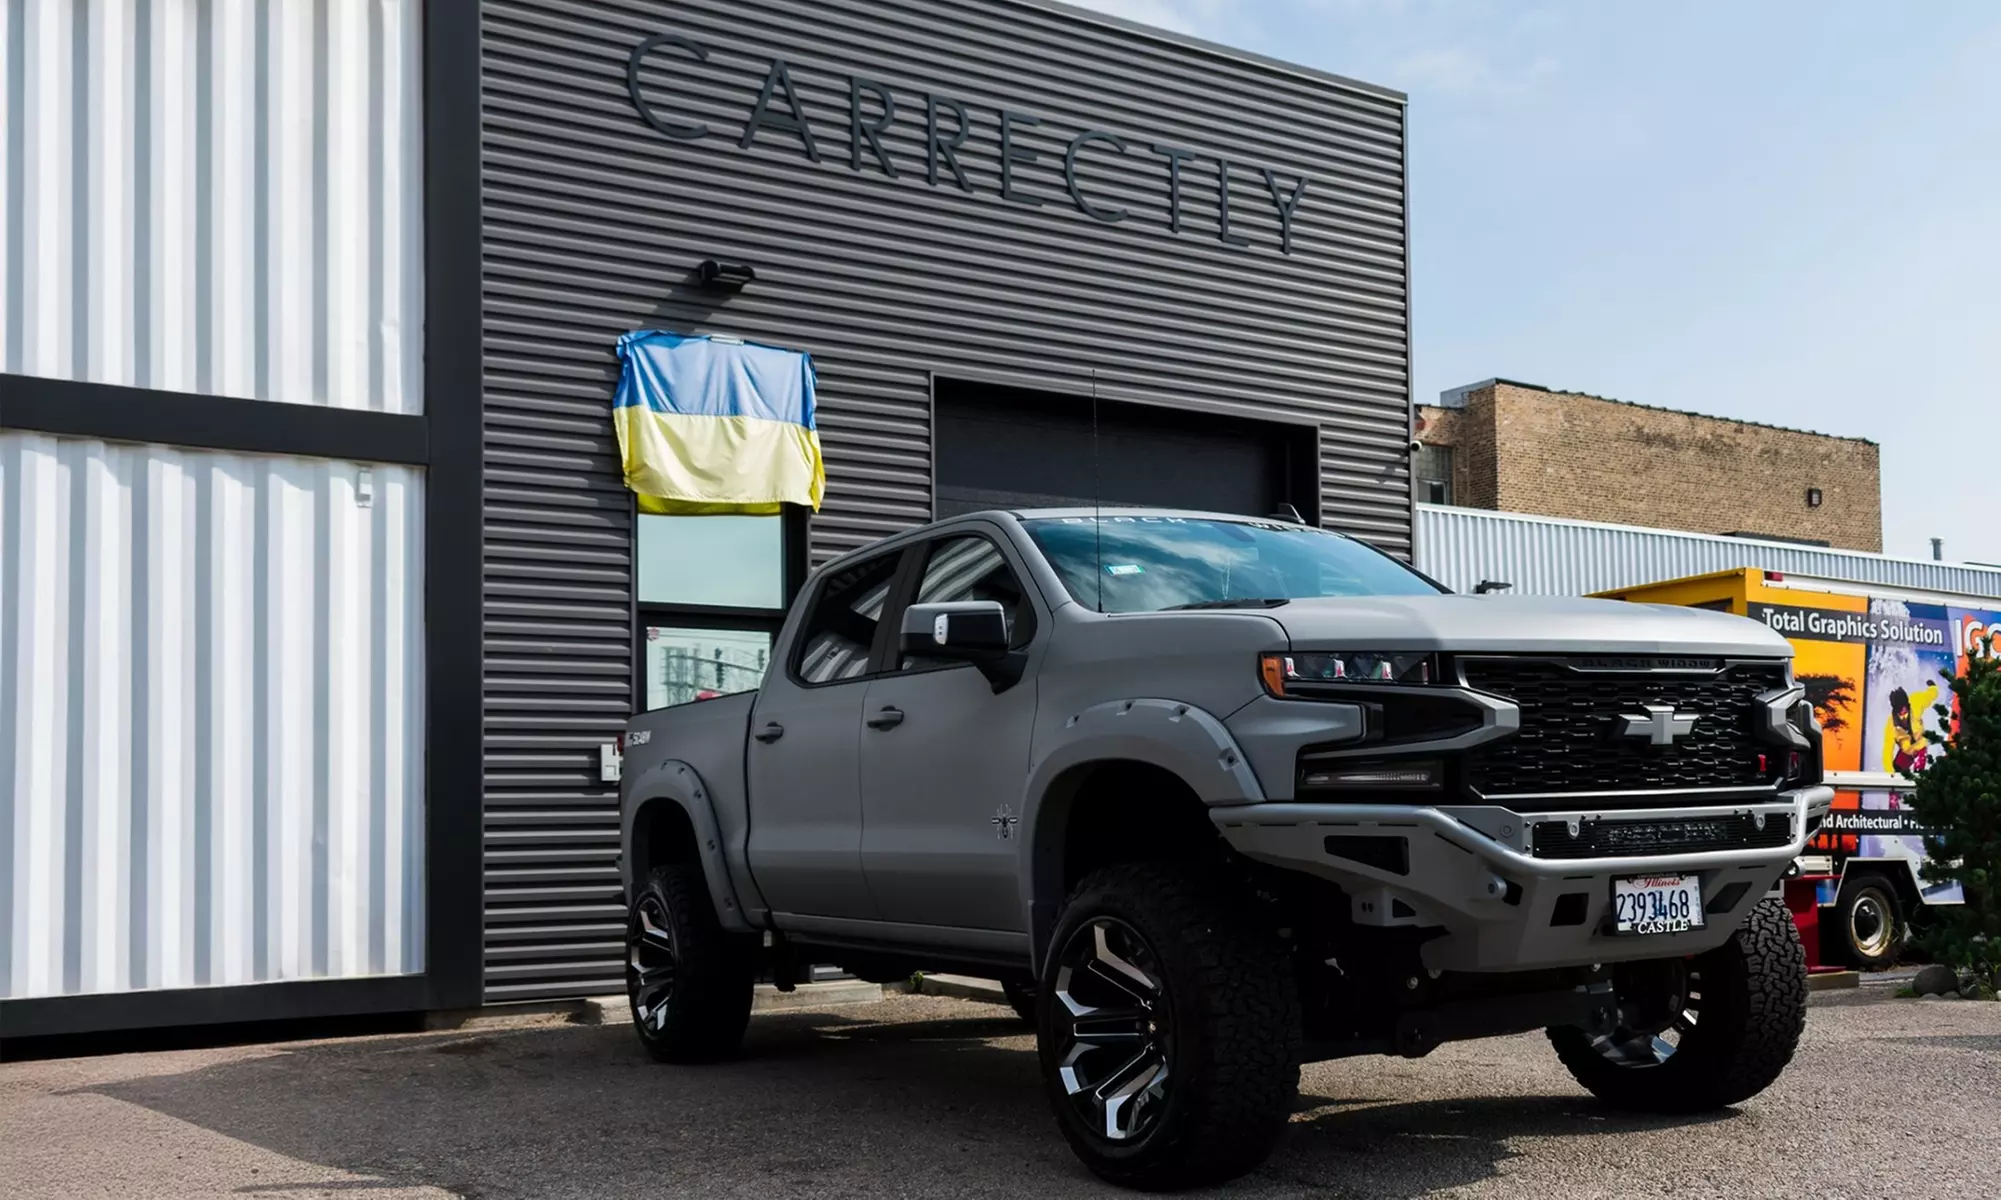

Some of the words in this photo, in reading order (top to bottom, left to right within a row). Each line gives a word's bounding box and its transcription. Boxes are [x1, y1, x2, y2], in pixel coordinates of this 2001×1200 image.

[626, 34, 1308, 255] CARRECTLY
[1763, 608, 1805, 632] Total
[1808, 612, 1878, 640] Graphics
[1881, 621, 1943, 645] Solution
[1658, 658, 1710, 669] WIDOW
[1819, 813, 1834, 829] nd
[1835, 813, 1902, 830] Architectural
[1633, 877, 1681, 889] Illinois
[1616, 889, 1690, 923] 2393468
[1637, 919, 1689, 934] CASTLE
